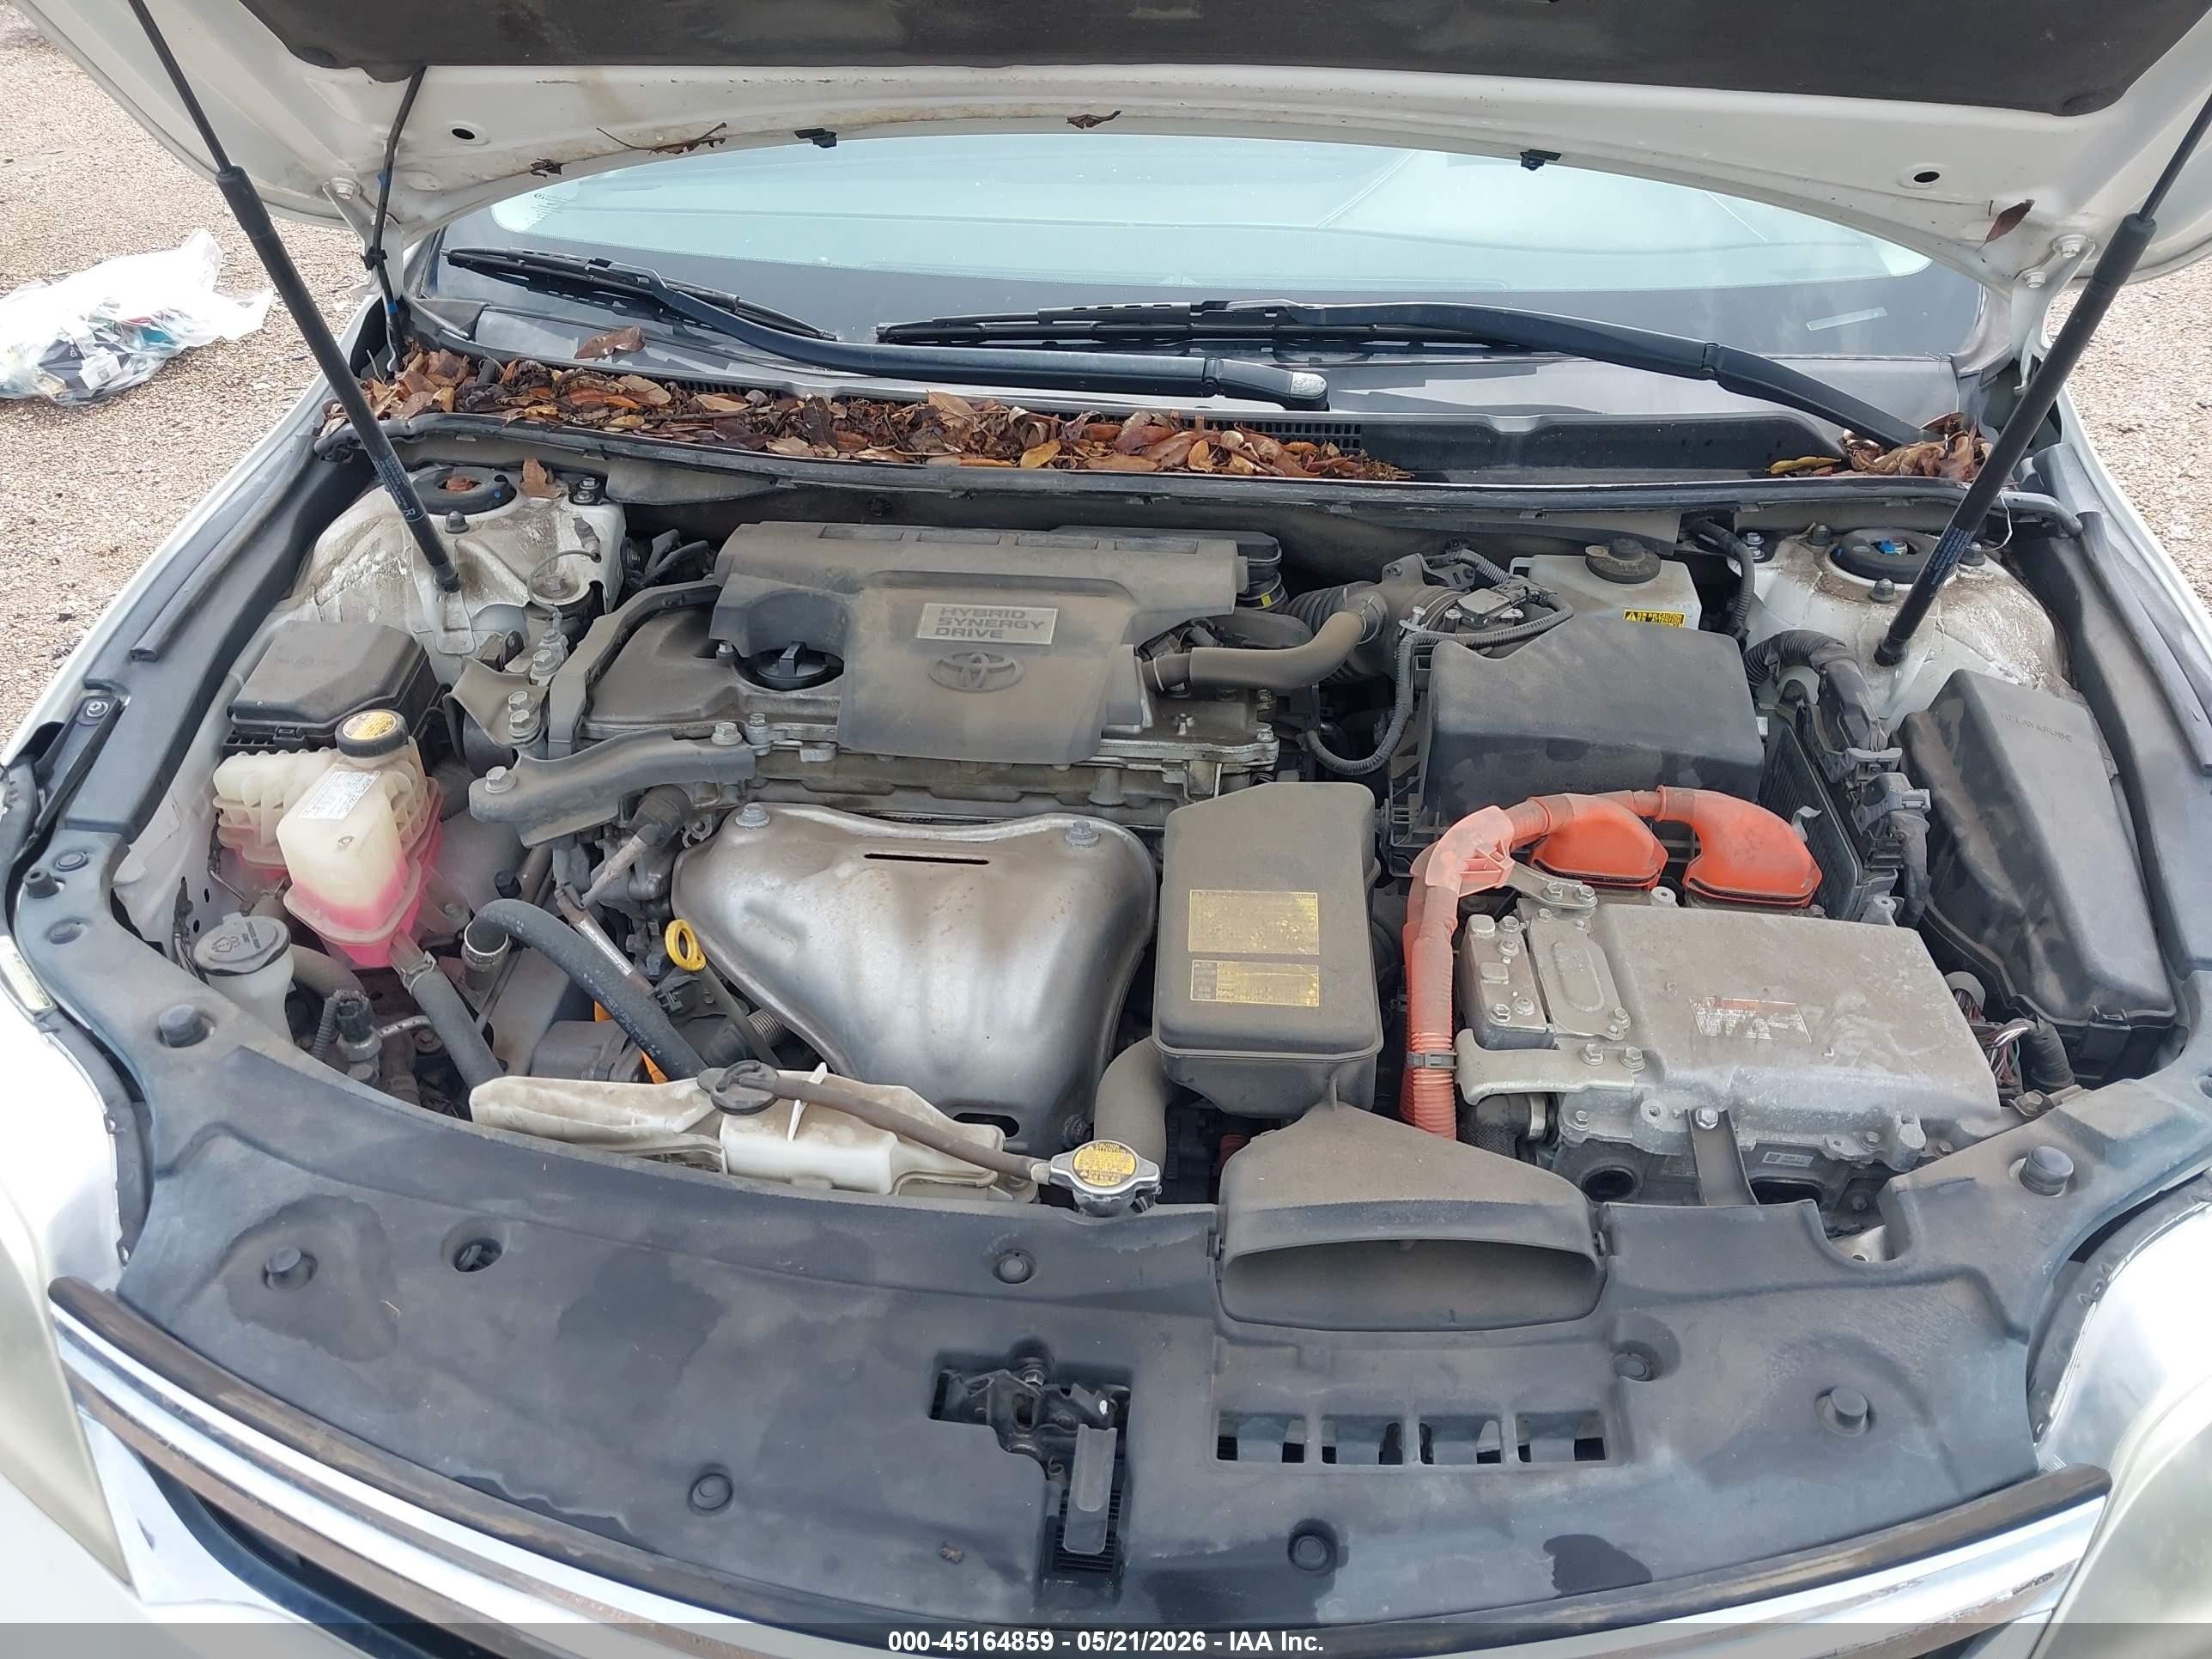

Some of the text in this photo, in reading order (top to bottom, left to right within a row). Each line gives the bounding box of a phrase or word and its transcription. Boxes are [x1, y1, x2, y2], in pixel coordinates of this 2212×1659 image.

[940, 607, 1026, 619] HYBRID
[938, 617, 1044, 630] SYNERGY
[935, 627, 1005, 639] DRIVE
